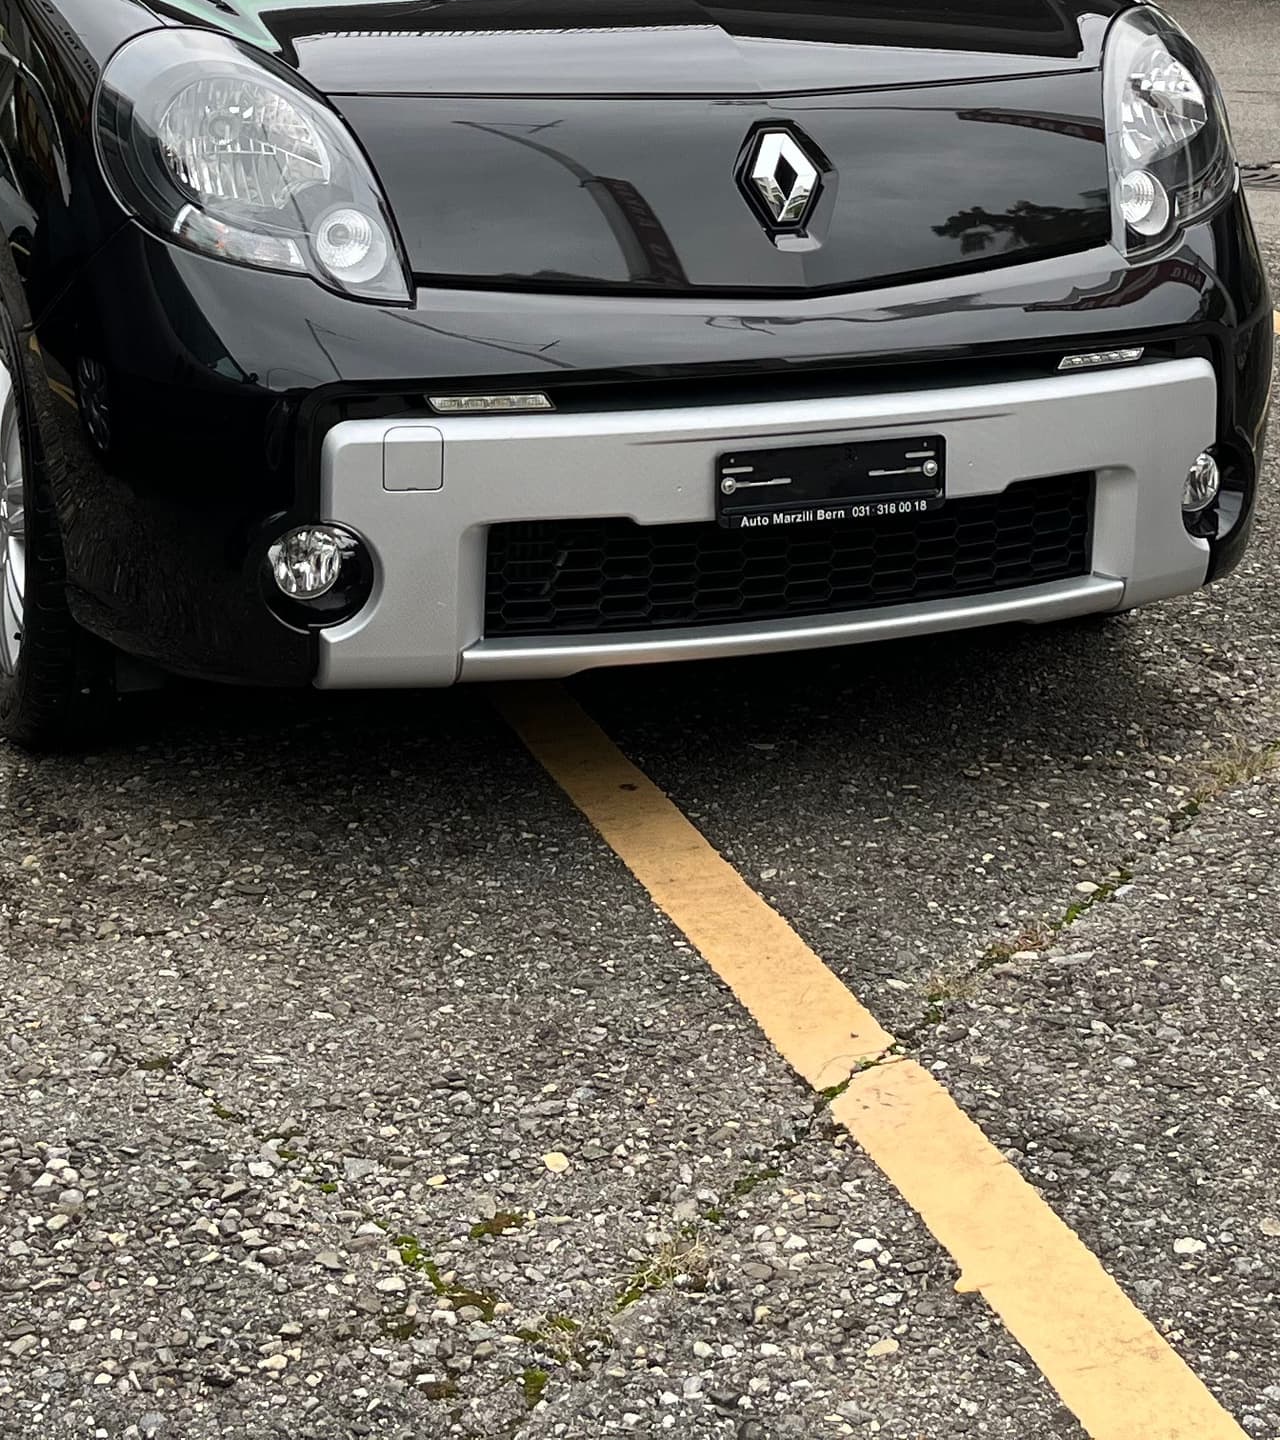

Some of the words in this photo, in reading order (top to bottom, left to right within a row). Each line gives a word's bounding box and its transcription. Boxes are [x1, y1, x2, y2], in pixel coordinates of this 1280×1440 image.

[740, 515, 770, 528] Auto
[772, 511, 813, 525] Marzili
[816, 509, 845, 521] Bern
[876, 503, 897, 515] 318
[898, 500, 912, 513] 00
[914, 499, 928, 511] 18
